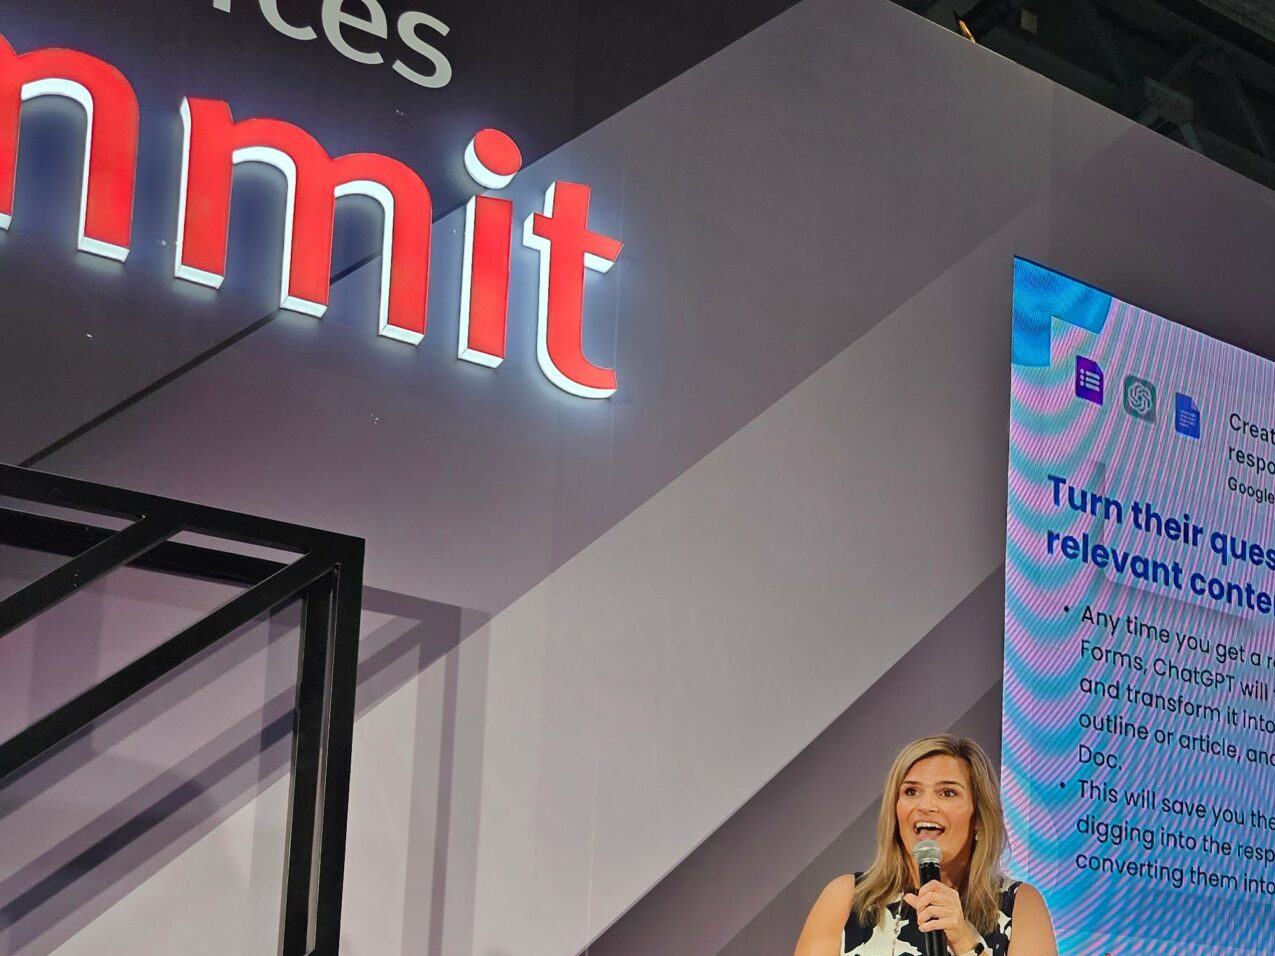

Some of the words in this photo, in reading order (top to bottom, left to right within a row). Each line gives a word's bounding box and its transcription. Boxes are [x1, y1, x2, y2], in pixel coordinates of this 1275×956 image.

[213, 0, 453, 89] ces
[1046, 472, 1123, 526] Turn
[1130, 497, 1203, 549] their
[1227, 475, 1274, 508] Google
[1045, 522, 1182, 590] relevant
[1080, 604, 1119, 637] Any
[1125, 614, 1170, 645] time
[1174, 632, 1210, 659] you
[1215, 638, 1245, 668] get
[1250, 651, 1261, 667] a
[1079, 638, 1148, 676] Forms,
[1152, 656, 1235, 694] ChatGPT
[1239, 676, 1268, 702] will
[1079, 672, 1120, 701] and
[1125, 683, 1221, 723] transform
[1226, 705, 1238, 727] it
[1242, 709, 1275, 735] into
[1077, 744, 1123, 772] Doc.
[1078, 708, 1149, 742] outline
[1154, 728, 1174, 747] or
[1178, 728, 1241, 764] article,
[1076, 778, 1118, 806] This
[1124, 786, 1156, 812] will
[1160, 797, 1207, 821] save
[1211, 805, 1245, 831] you
[1075, 813, 1154, 850] digging
[1160, 827, 1202, 852] into
[1202, 833, 1232, 857] the
[1075, 851, 1184, 889] converting
[1189, 866, 1238, 890] them
[1243, 874, 1275, 896] into
